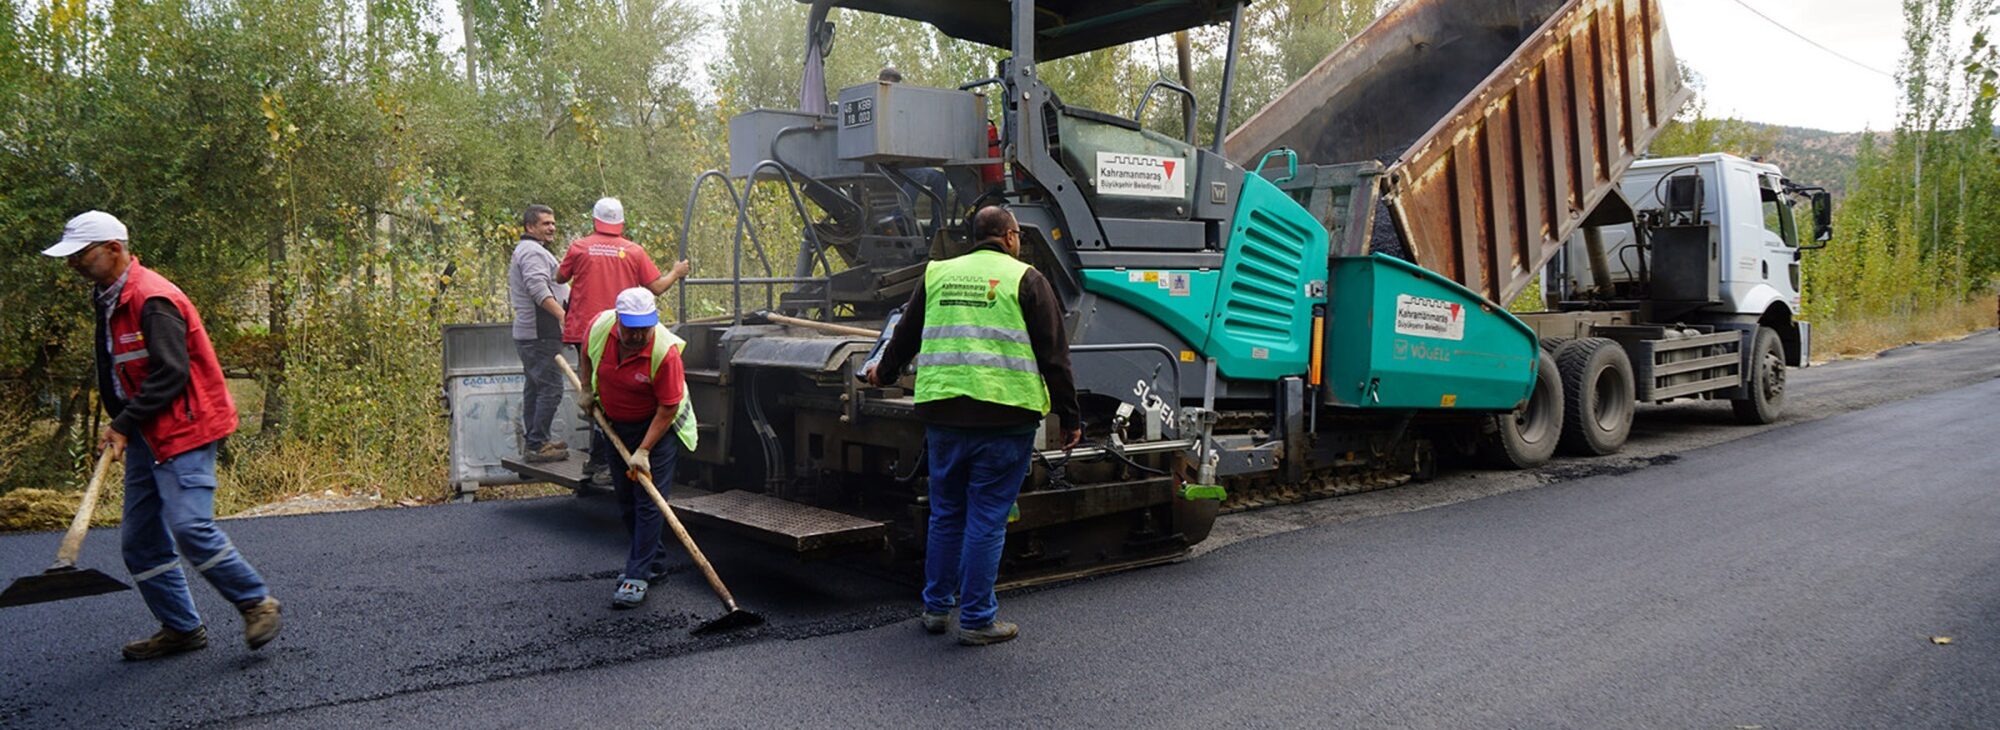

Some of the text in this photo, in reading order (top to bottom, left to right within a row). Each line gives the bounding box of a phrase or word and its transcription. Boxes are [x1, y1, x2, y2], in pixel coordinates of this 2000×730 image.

[1100, 167, 1162, 182] Kahramanmaraş
[1101, 180, 1162, 192] Büyükşehir Belediyesi
